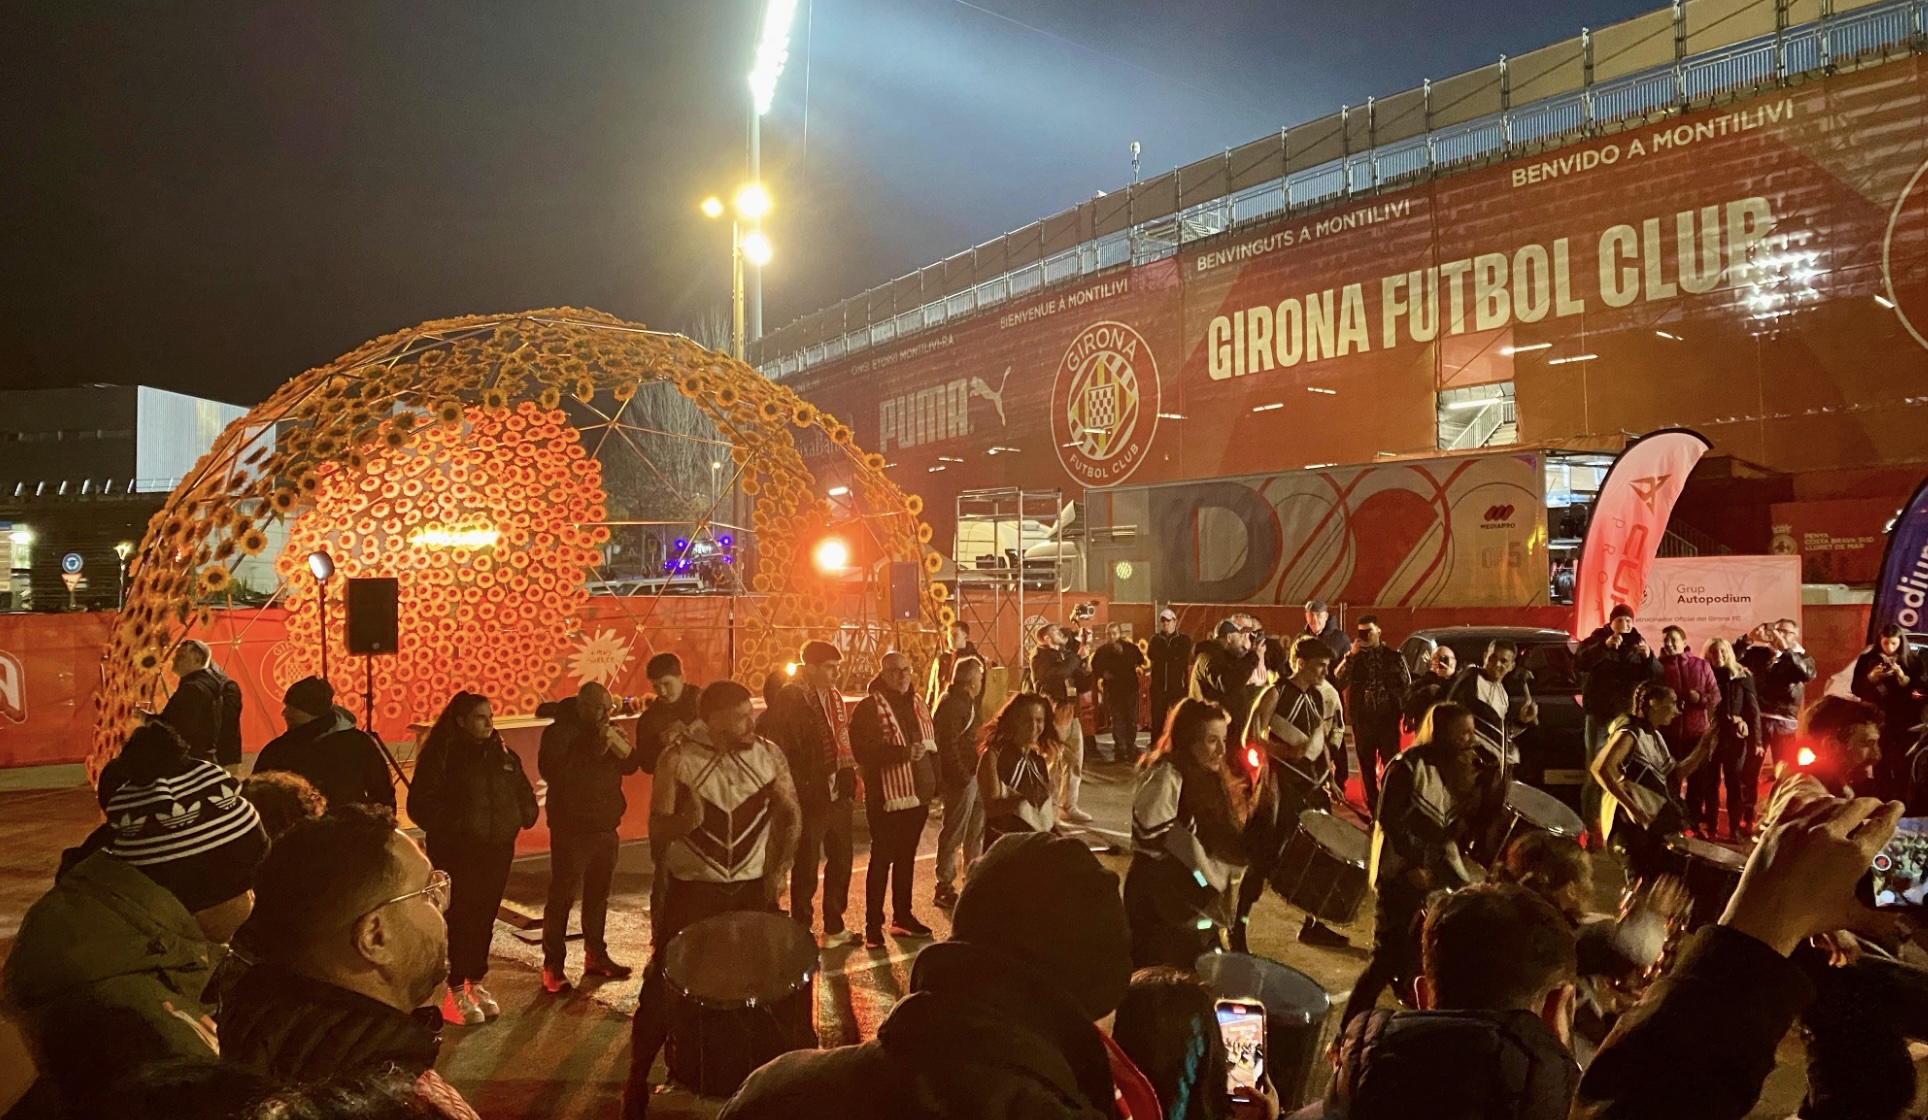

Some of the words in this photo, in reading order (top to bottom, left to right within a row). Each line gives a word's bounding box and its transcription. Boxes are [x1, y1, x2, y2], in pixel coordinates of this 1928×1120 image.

[1512, 145, 1620, 188] BENVIDO
[1627, 138, 1646, 160] A
[1653, 99, 1793, 153] MONTILIVI
[1197, 229, 1294, 272] BENVINGUTS
[1299, 225, 1311, 242] A
[1316, 198, 1410, 236] MONTILIVI
[1000, 302, 1056, 330] BIENVENUE
[1068, 278, 1128, 309] MONTILIVI
[1208, 283, 1370, 381] GIRONA
[1382, 237, 1585, 349] FUTBOL
[1599, 196, 1773, 308] CLUB
[1067, 327, 1137, 372] GIRONA
[879, 378, 968, 453] PUMA
[1070, 453, 1109, 479] FUTBOL
[1112, 443, 1139, 474] CLUB
[1480, 522, 1516, 530] MEDIAPRO
[1676, 583, 1705, 595] Grup
[1677, 593, 1751, 605] Autopodium
